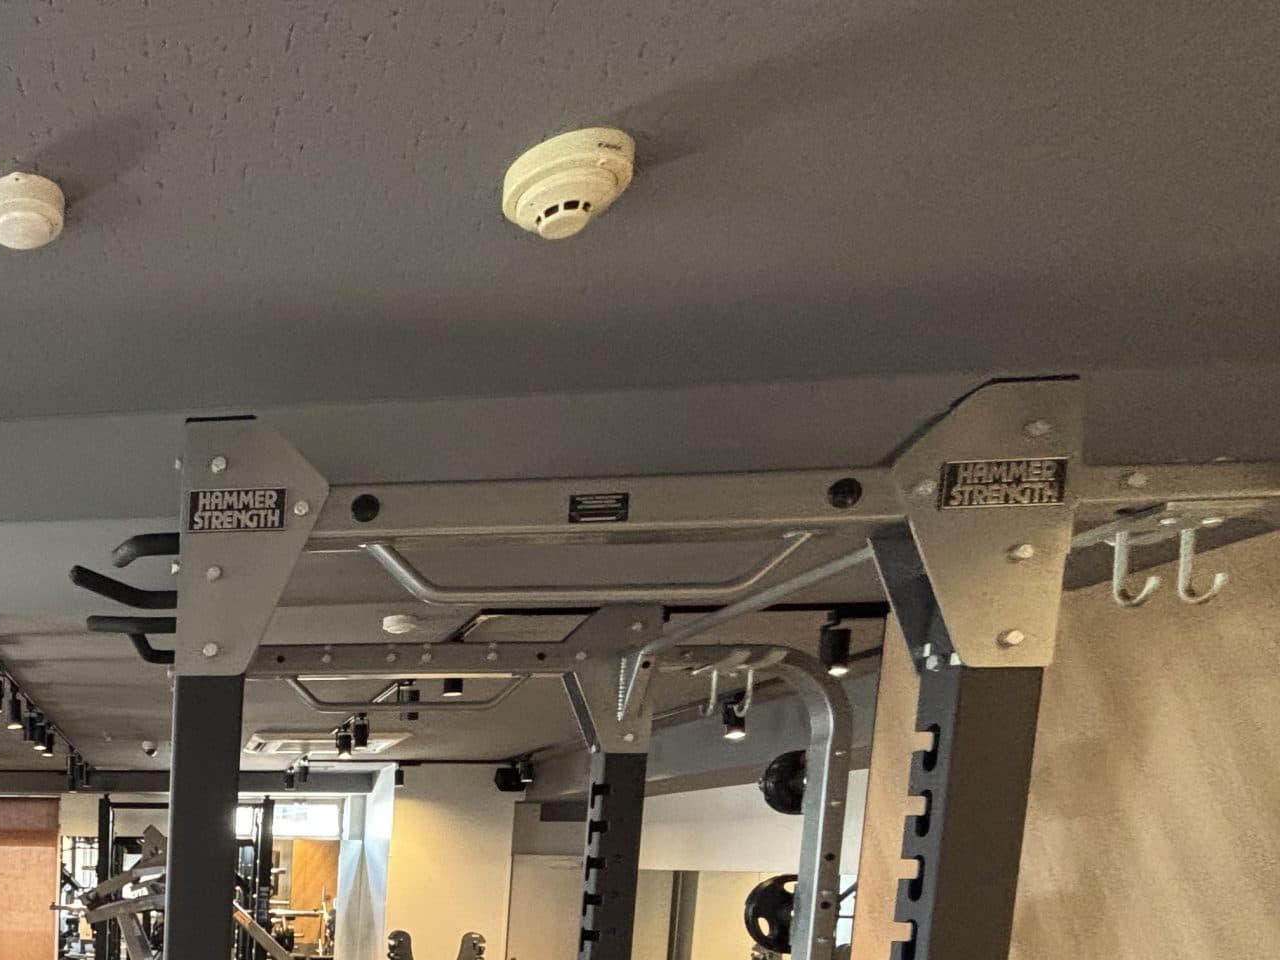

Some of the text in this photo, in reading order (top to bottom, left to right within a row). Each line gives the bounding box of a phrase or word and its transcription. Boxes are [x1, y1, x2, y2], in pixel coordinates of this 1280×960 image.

[956, 461, 1057, 484] HAMMER
[198, 490, 278, 511] HAMMER
[949, 481, 1058, 506] STRENGTH
[192, 509, 281, 530] STRENGTH
